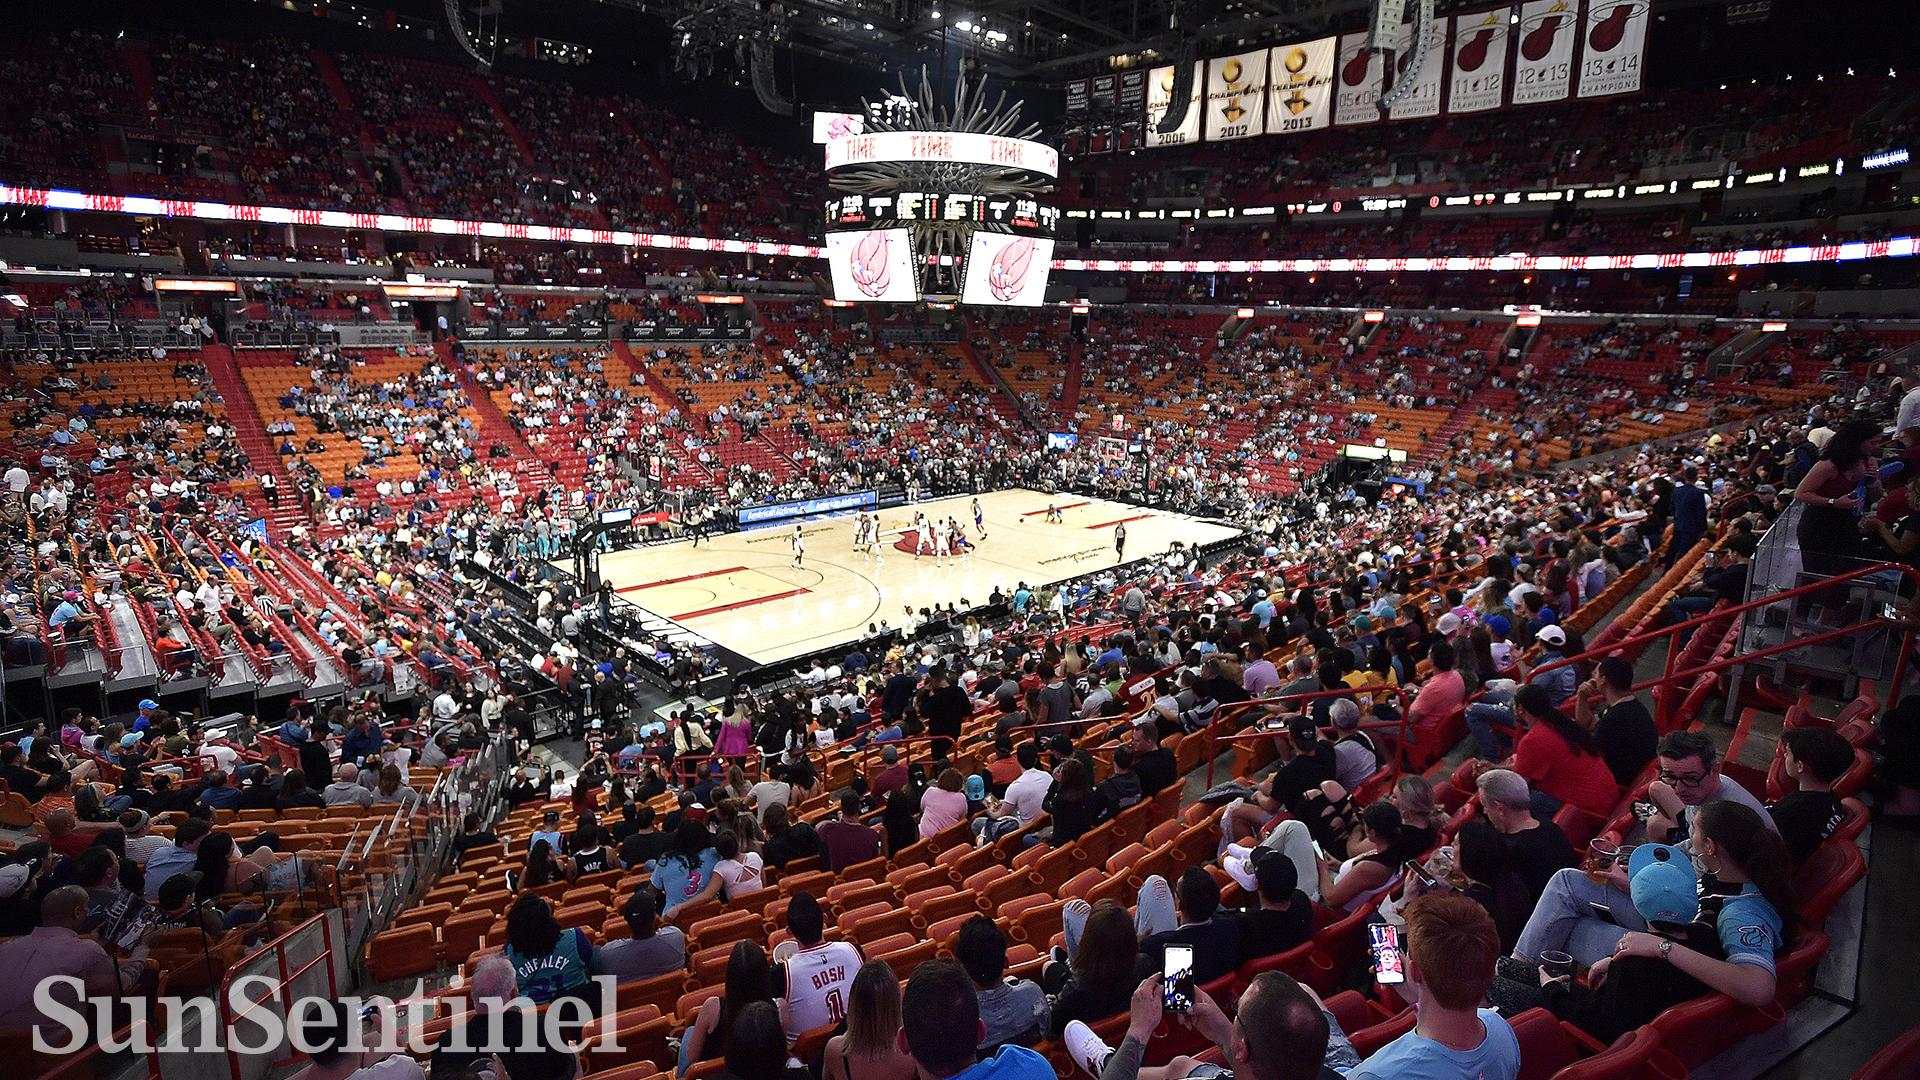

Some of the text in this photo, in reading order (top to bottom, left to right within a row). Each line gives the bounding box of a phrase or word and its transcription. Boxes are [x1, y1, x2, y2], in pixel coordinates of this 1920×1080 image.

[1519, 64, 1568, 84] 12 13
[1585, 55, 1638, 77] 13 14
[1455, 79, 1468, 94] 11
[1484, 74, 1500, 90] 12
[1581, 80, 1638, 95] CHAMPIONS
[1220, 126, 1248, 139] 2012
[1283, 117, 1313, 131] 2013
[847, 138, 877, 160] TIME
[911, 136, 953, 158] TIME
[1158, 132, 1186, 145] 2006
[991, 140, 1023, 165] TIME
[684, 870, 702, 896] 3
[811, 965, 846, 990] BOSH
[825, 988, 847, 1025] 1
